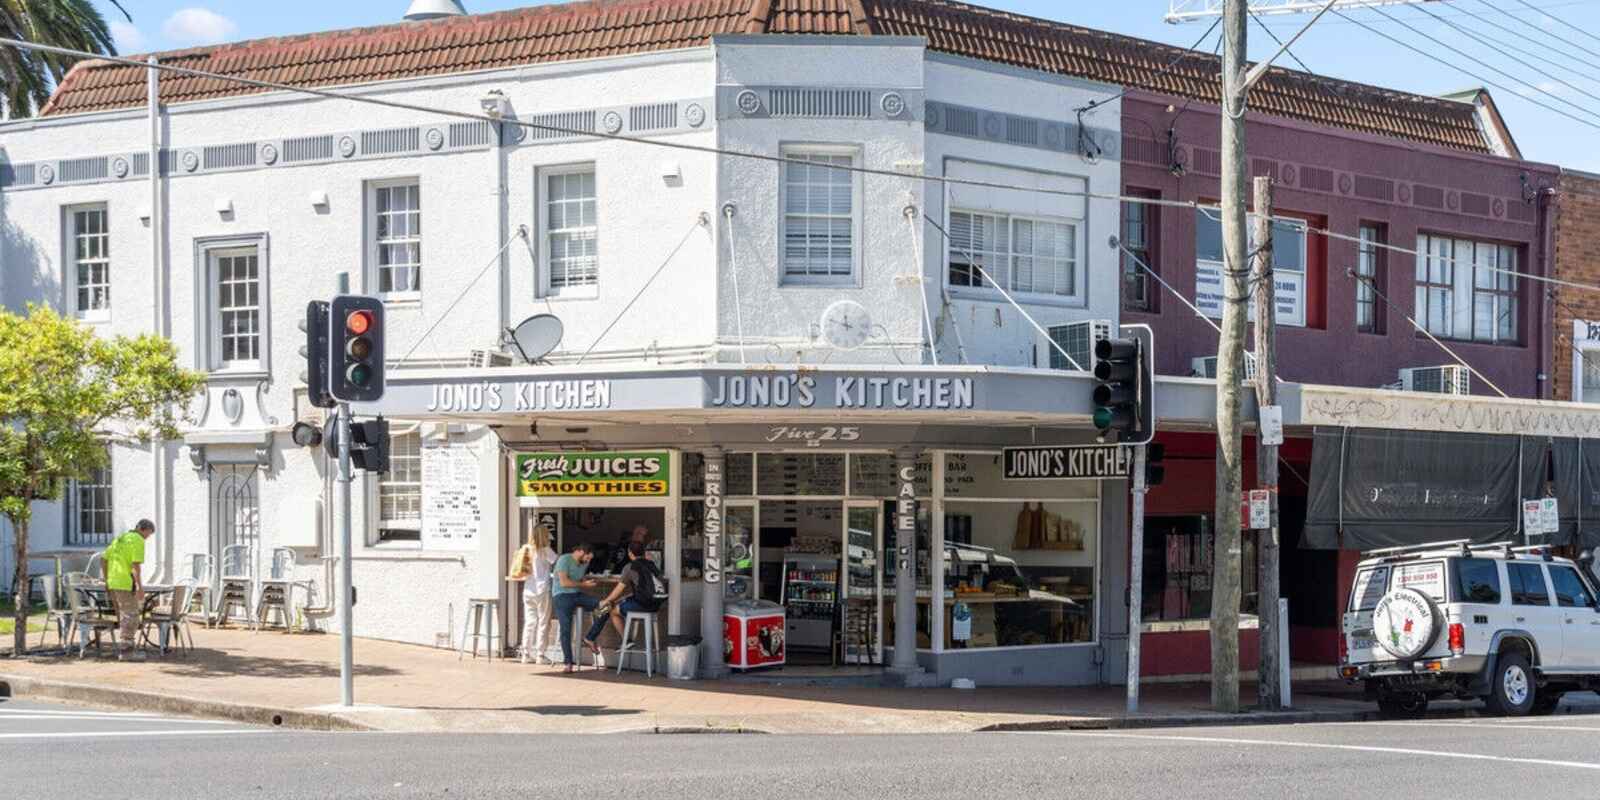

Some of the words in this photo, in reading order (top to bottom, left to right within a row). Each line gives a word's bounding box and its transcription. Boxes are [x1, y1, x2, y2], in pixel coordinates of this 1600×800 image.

[427, 381, 502, 411] JONO'S
[514, 380, 612, 410] KITCHEN
[712, 374, 816, 408] JONO'S
[835, 377, 974, 409] KITCHEN
[820, 427, 860, 440] 25
[522, 456, 569, 478] Fresh
[569, 457, 661, 476] JUICES
[1008, 449, 1064, 477] JONO'S
[527, 482, 662, 493] SMOOTHIES
[900, 467, 915, 529] CAFE
[705, 482, 720, 583] ROASTING
[1394, 592, 1430, 618] Electrical
